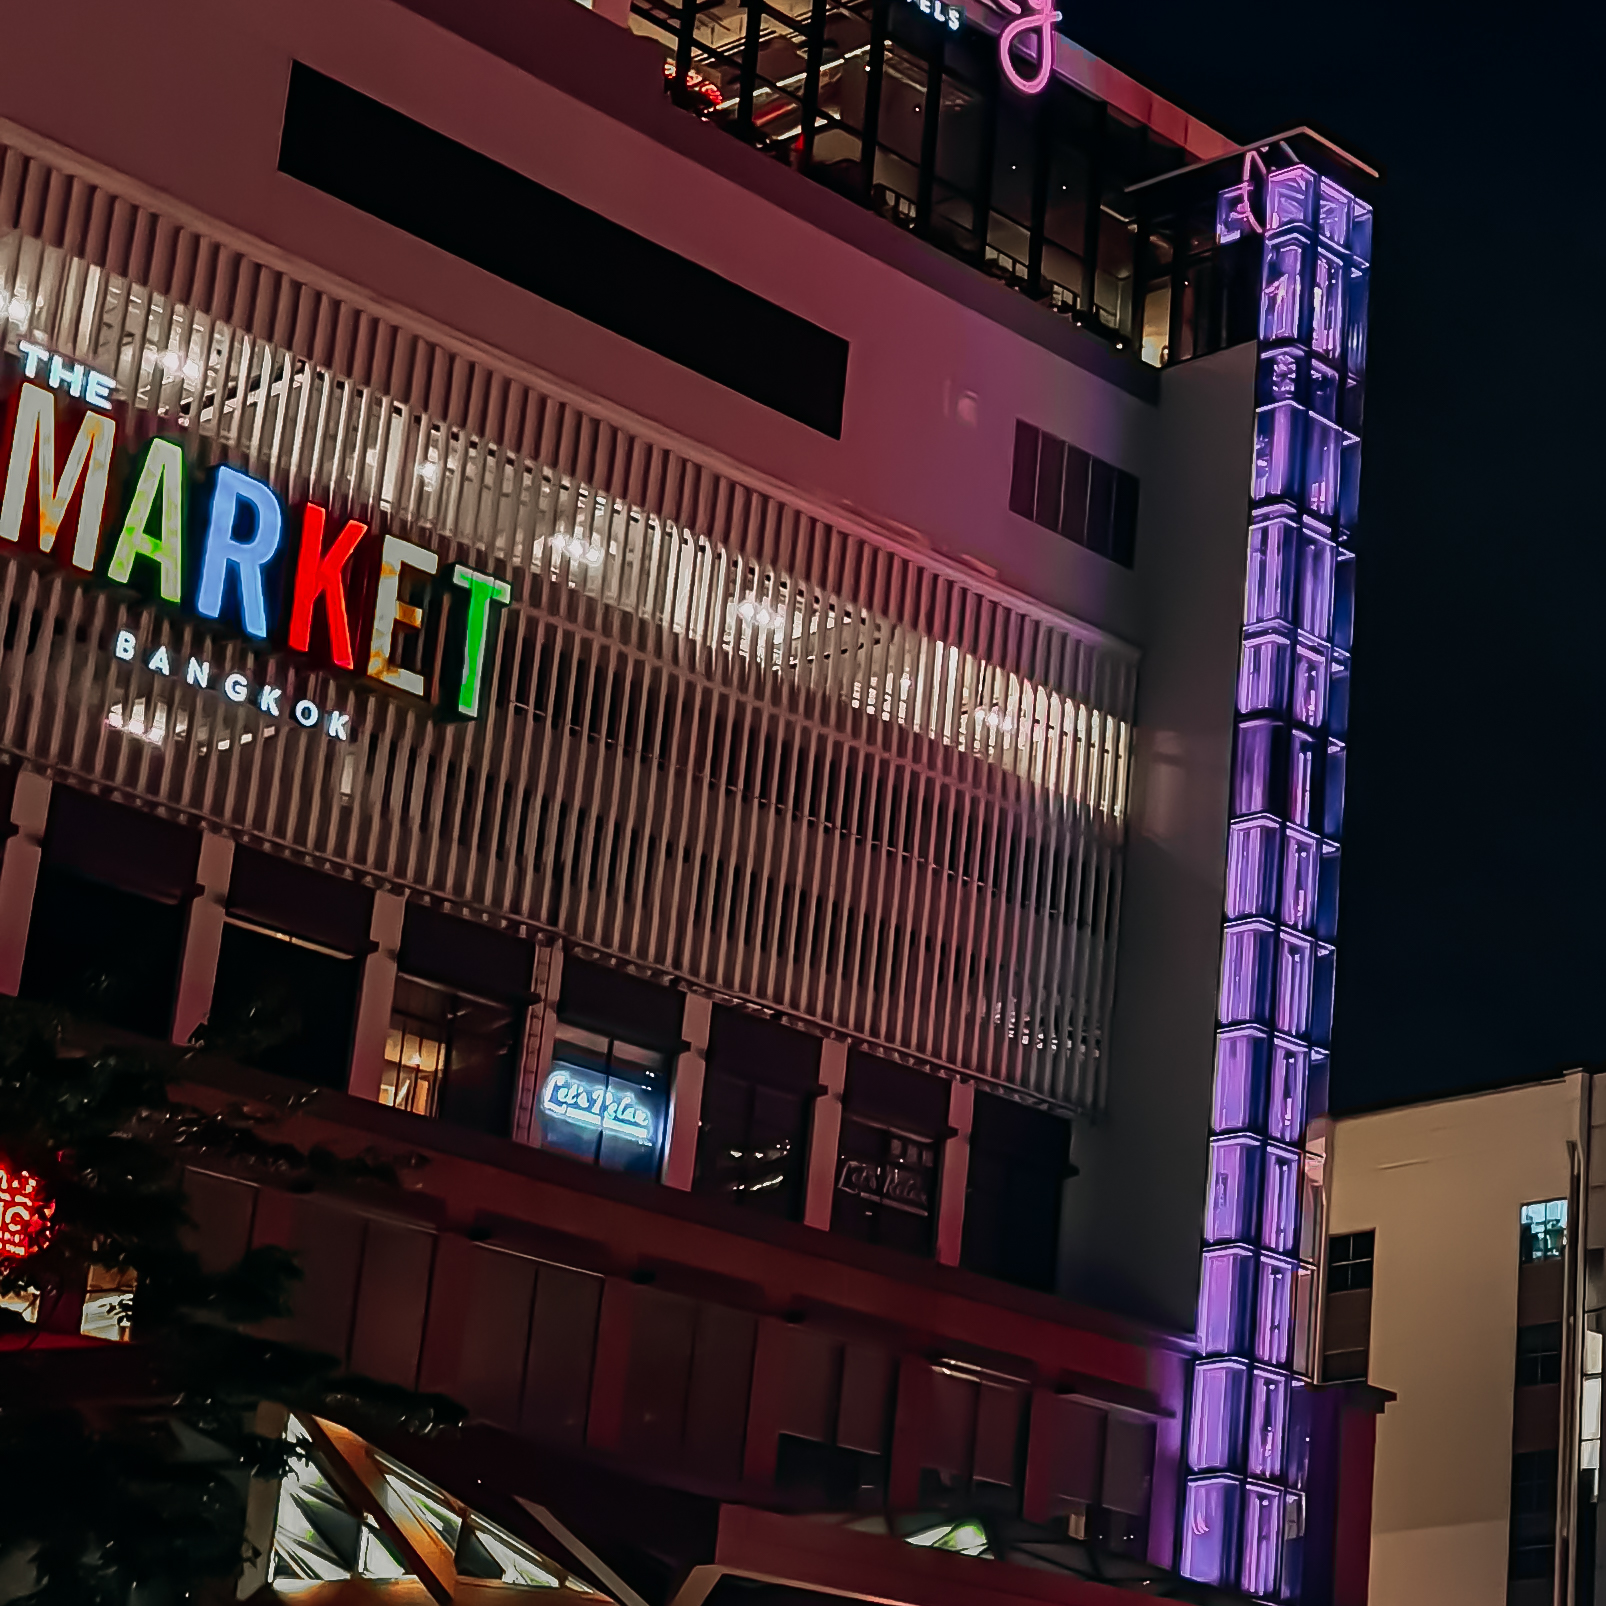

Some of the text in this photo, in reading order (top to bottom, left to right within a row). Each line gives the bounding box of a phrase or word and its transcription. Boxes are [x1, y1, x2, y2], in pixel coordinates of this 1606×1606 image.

[18, 340, 117, 410] THE
[0, 381, 512, 719] MARKET
[115, 629, 349, 741] BANGKOK
